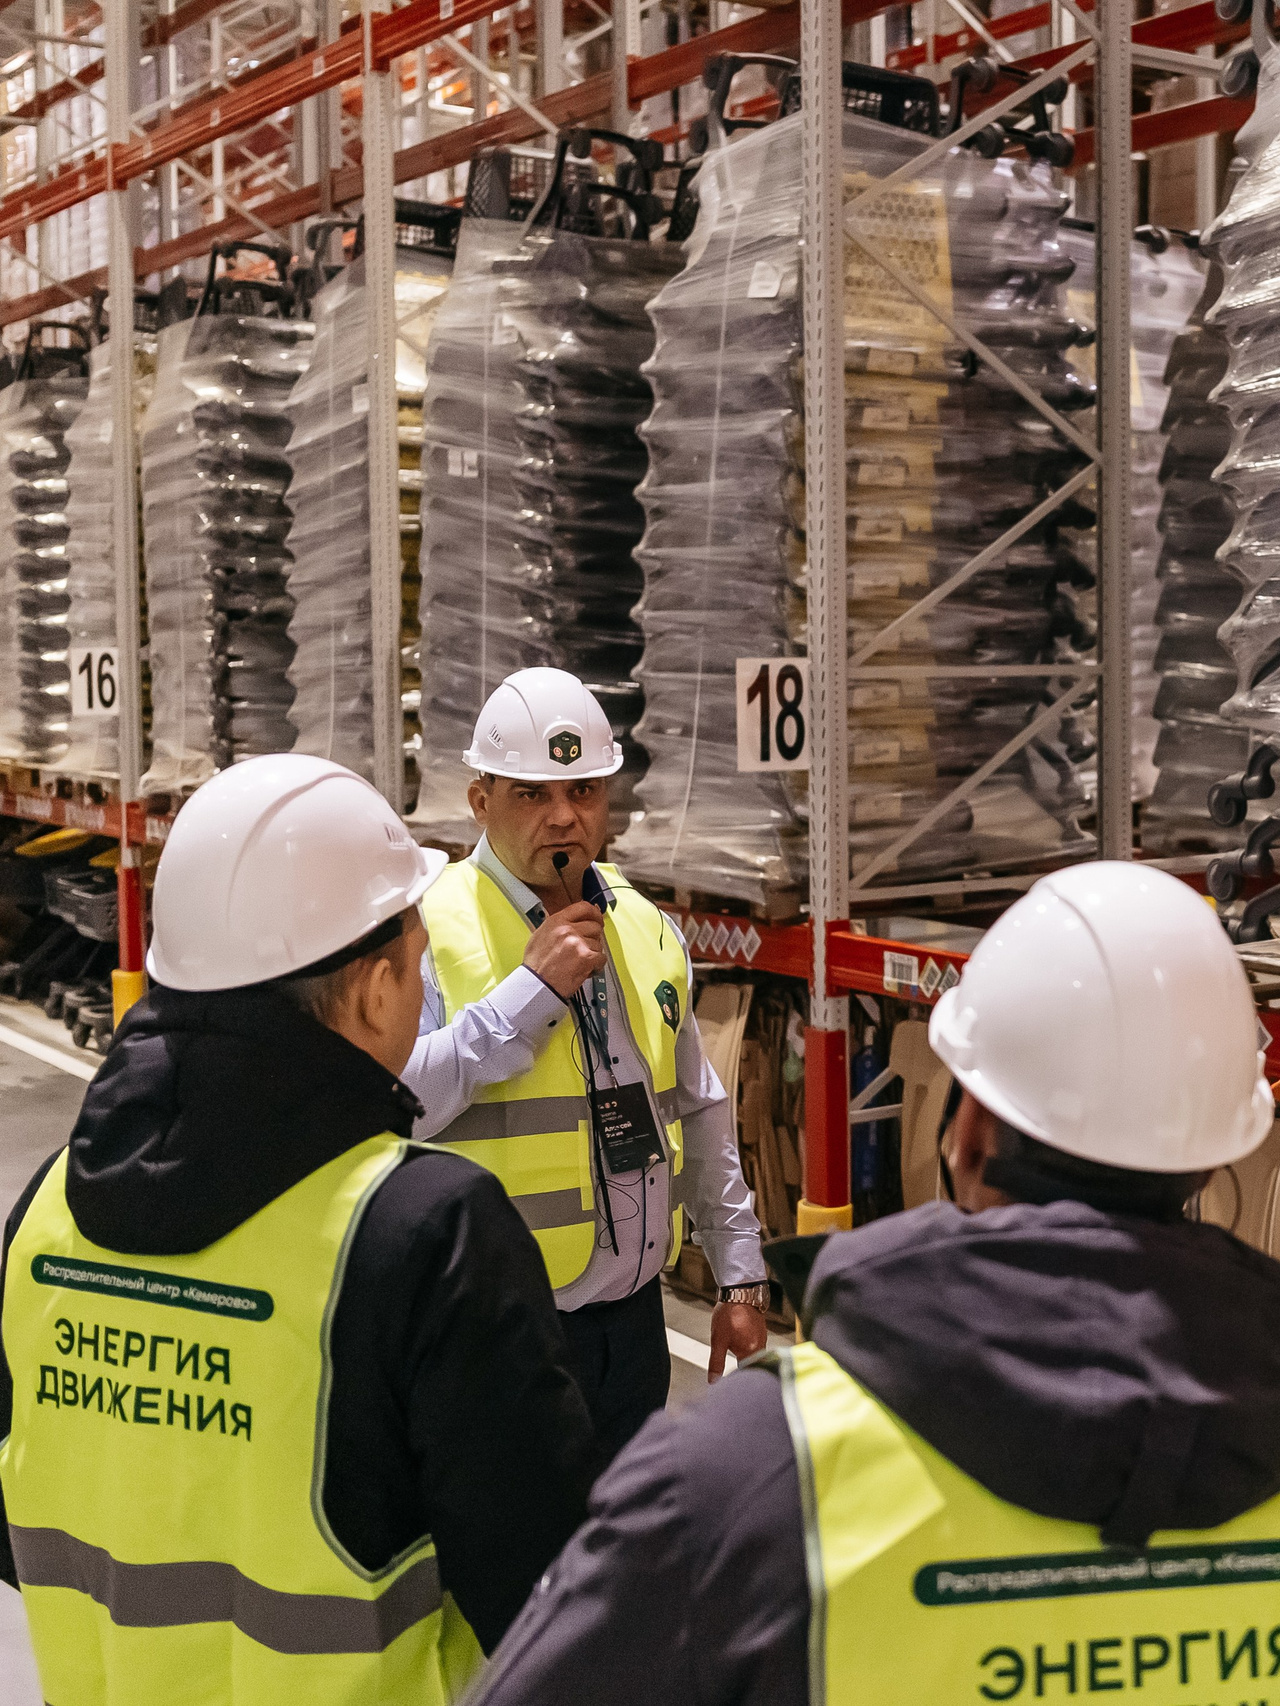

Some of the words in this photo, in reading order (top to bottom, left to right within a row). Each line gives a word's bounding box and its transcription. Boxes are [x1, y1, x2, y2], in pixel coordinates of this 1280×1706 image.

[79, 652, 116, 709] 16
[747, 664, 805, 762] 18
[43, 1262, 145, 1290] Распределительный
[147, 1282, 181, 1299] центр
[183, 1286, 258, 1311] «Кемерово»
[54, 1317, 231, 1385] ЭНЕРГИЯ
[36, 1364, 253, 1443] ДВИЖЕНИЯ
